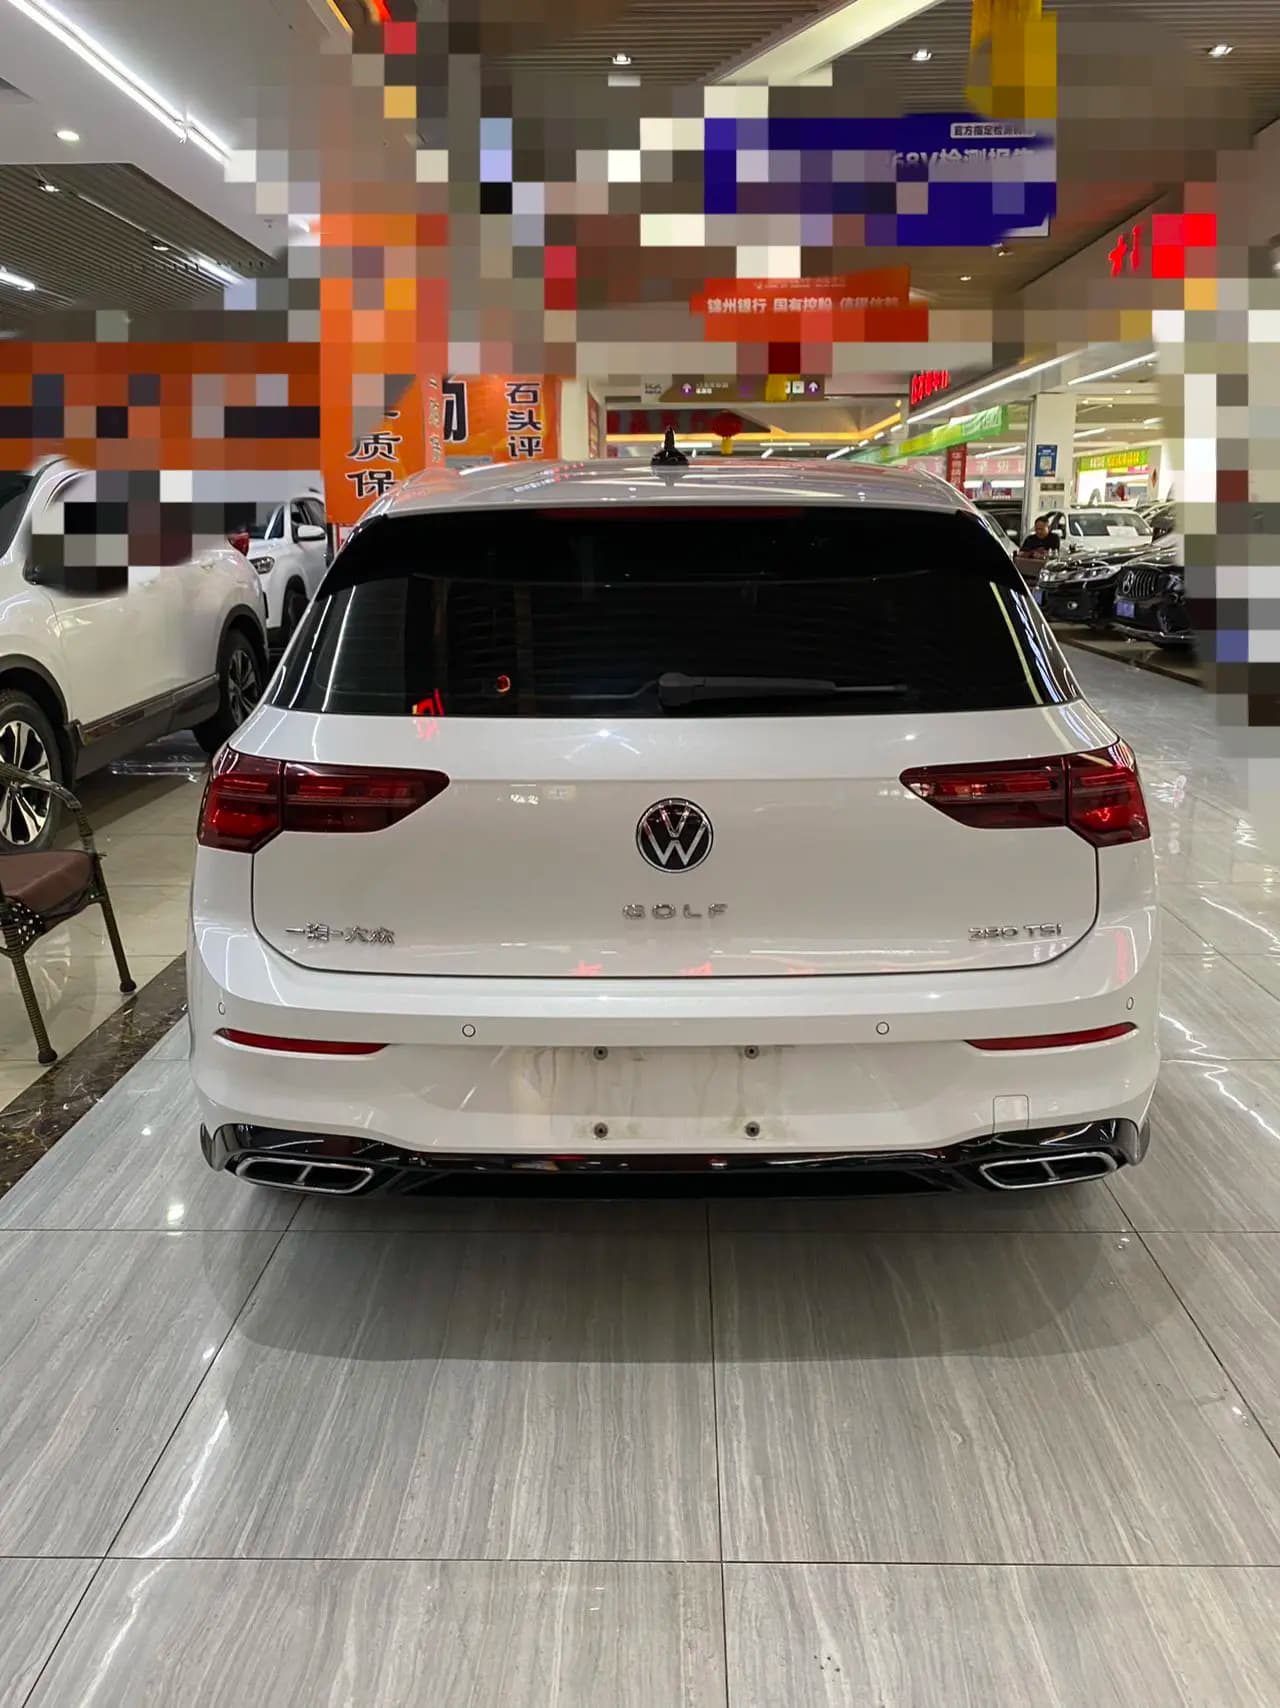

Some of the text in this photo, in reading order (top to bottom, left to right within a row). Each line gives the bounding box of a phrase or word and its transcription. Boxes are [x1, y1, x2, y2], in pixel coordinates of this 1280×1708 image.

[506, 381, 542, 458] 石头评
[622, 903, 729, 920] GOLF
[1023, 922, 1062, 938] TSI
